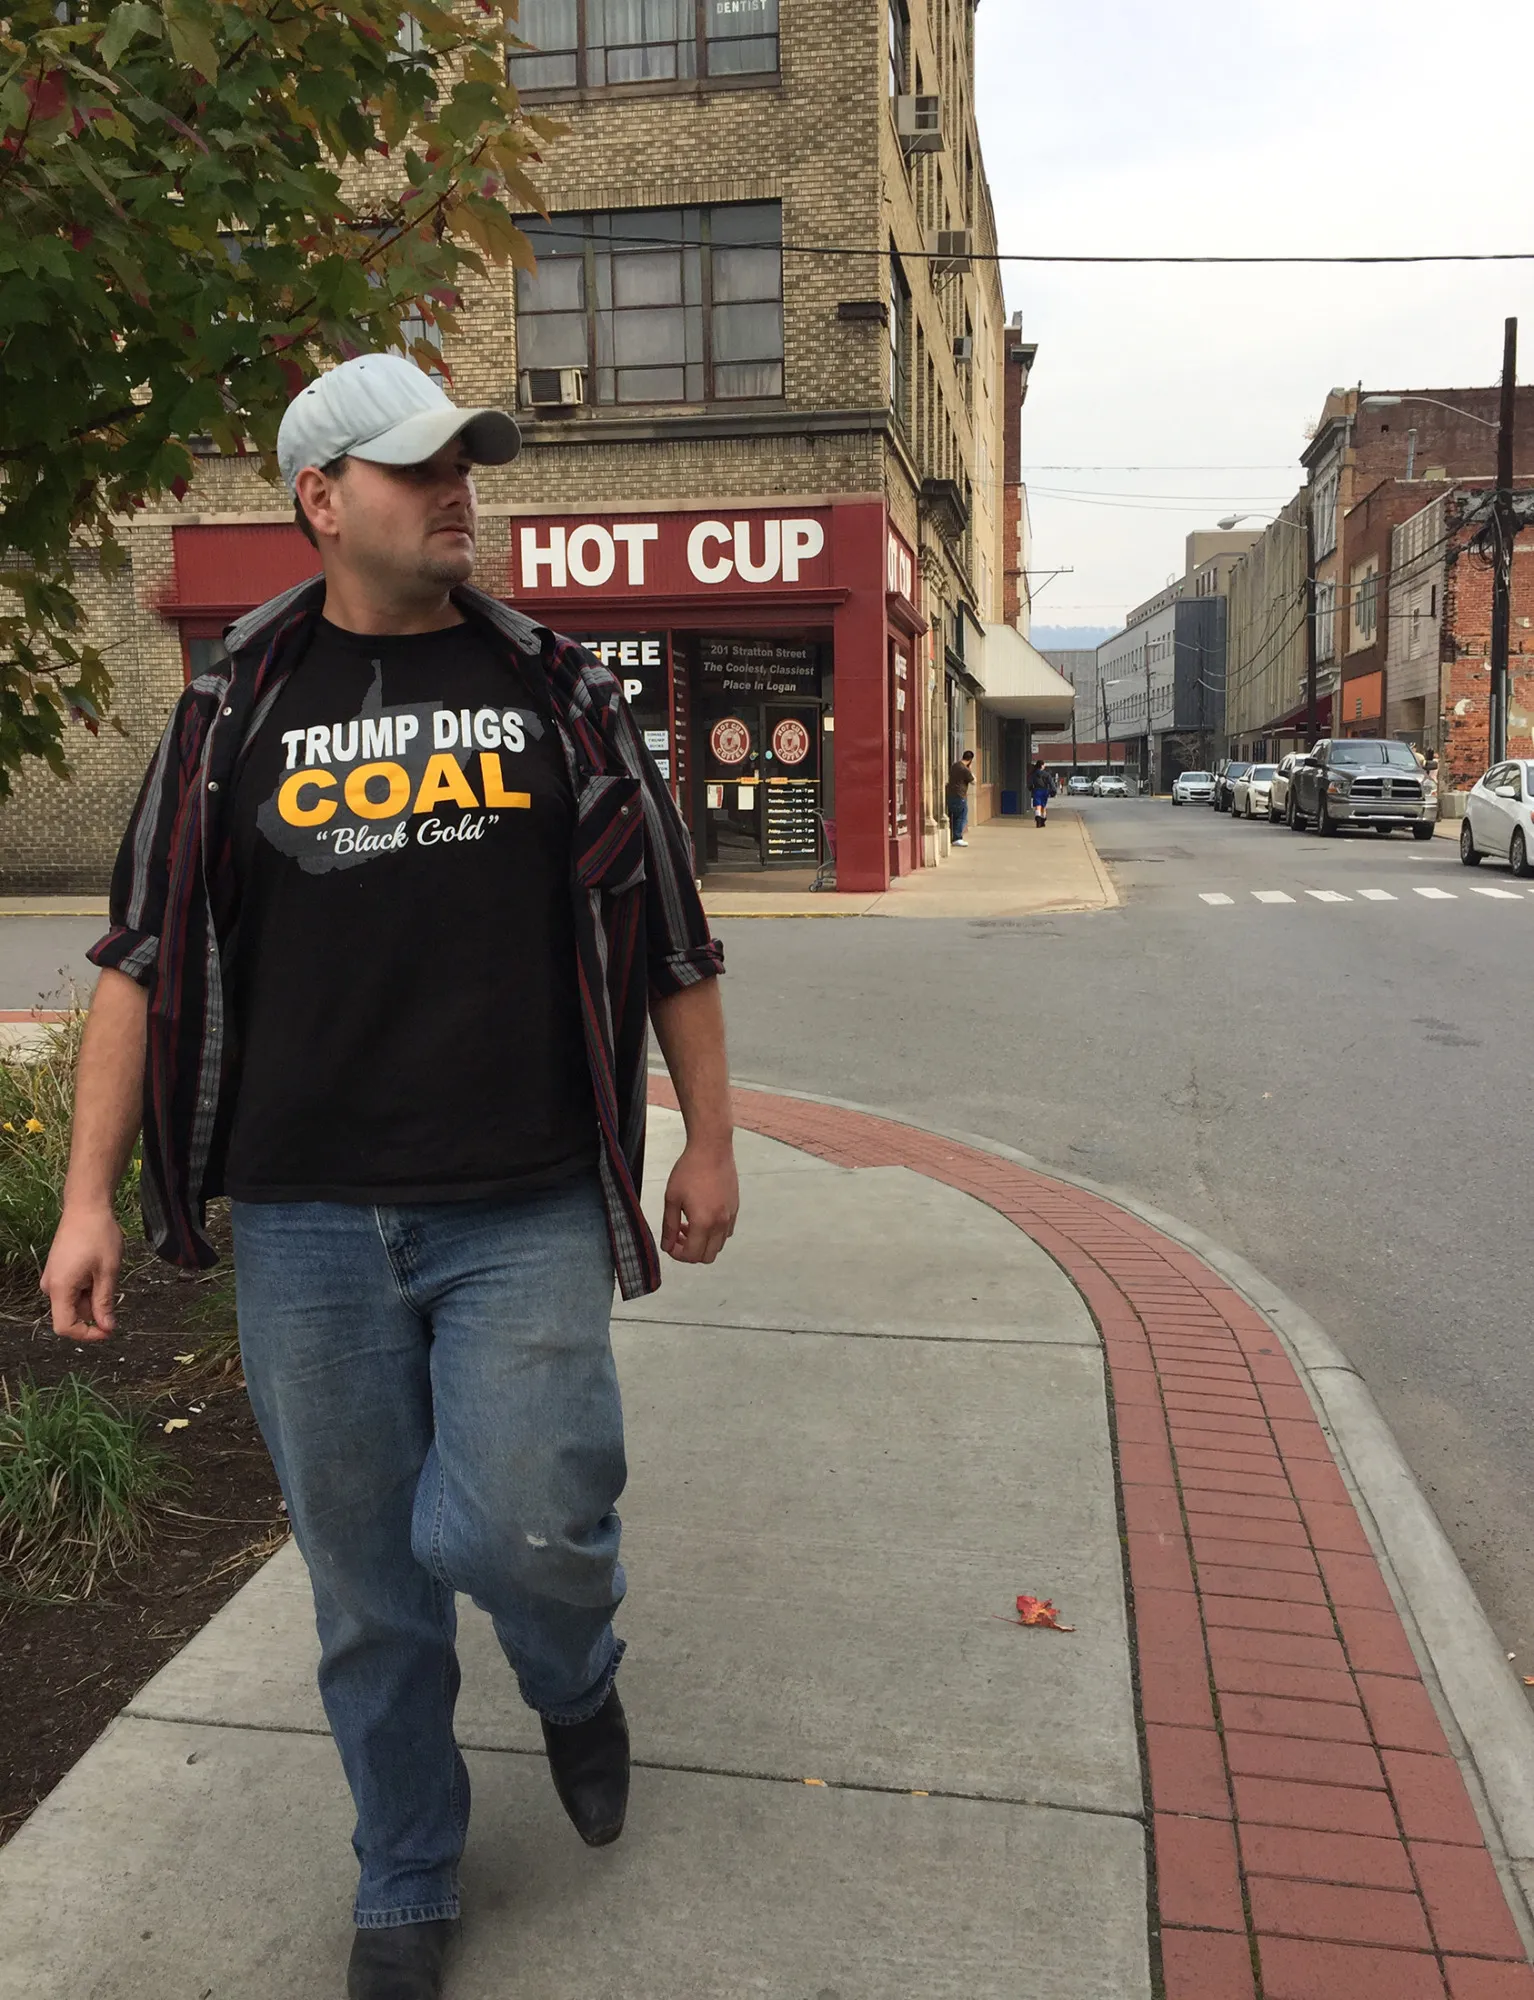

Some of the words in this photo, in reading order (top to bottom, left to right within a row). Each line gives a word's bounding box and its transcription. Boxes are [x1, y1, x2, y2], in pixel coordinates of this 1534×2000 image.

[717, 0, 767, 14] DENTIST
[520, 523, 658, 588] HOT
[687, 518, 824, 584] CUP
[711, 645, 729, 655] 201
[732, 646, 773, 657] Stratton
[776, 648, 806, 659] Street
[703, 661, 723, 672] The
[725, 663, 767, 676] Coolest,
[769, 665, 815, 675] Classiest
[722, 680, 751, 690] Place
[754, 681, 764, 689] In
[766, 681, 797, 693] Logan
[716, 723, 729, 735] HOT
[731, 723, 745, 735] CUP
[777, 724, 790, 736] HOT
[791, 724, 805, 736] CUP
[281, 714, 419, 769] TRUMP
[433, 709, 525, 752] DIGS
[716, 747, 745, 760] COFFEE
[777, 748, 804, 760] COFFEE
[277, 752, 531, 827] COAL
[316, 821, 409, 855] “Black
[417, 814, 499, 846] Gold”
